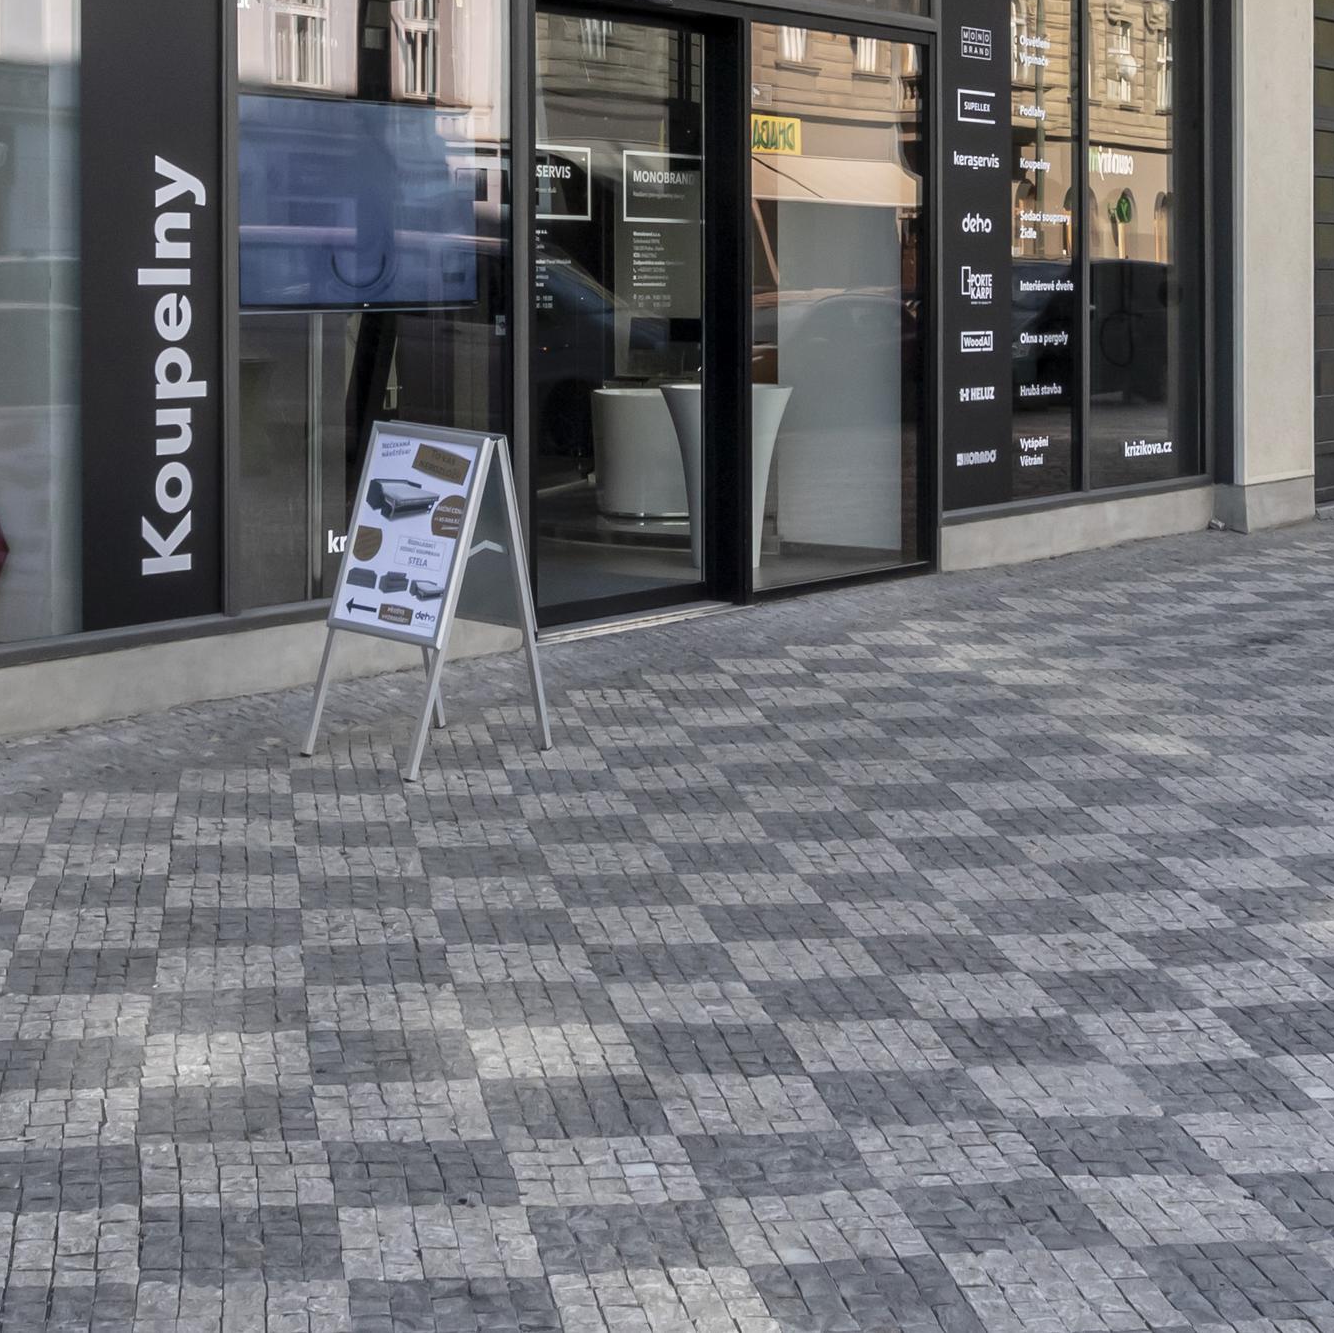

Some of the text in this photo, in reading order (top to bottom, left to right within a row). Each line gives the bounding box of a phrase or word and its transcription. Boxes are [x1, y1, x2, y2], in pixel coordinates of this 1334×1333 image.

[963, 31, 990, 43] MONO
[963, 44, 990, 56] BRAND
[963, 100, 991, 112] SUPELLEX
[1020, 105, 1046, 121] Podlahy
[953, 150, 1000, 169] keraservis
[1020, 157, 1051, 172] Koupelny
[633, 170, 695, 185] MONOBRAND
[962, 212, 992, 233] deho
[970, 274, 992, 287] PORTE
[1020, 279, 1074, 292] Interiérové dveře
[970, 287, 992, 300] KARPI
[1020, 332, 1037, 344] Okna
[1044, 331, 1069, 346] pergoly
[138, 155, 207, 575] Koupelny
[970, 386, 995, 401] HELUZ
[1020, 382, 1063, 397] Hrubá stavba
[1020, 436, 1049, 452] Vytápění
[1124, 440, 1173, 457] krizikova.cz
[1020, 453, 1044, 467] Větrání
[415, 610, 435, 623] deho
